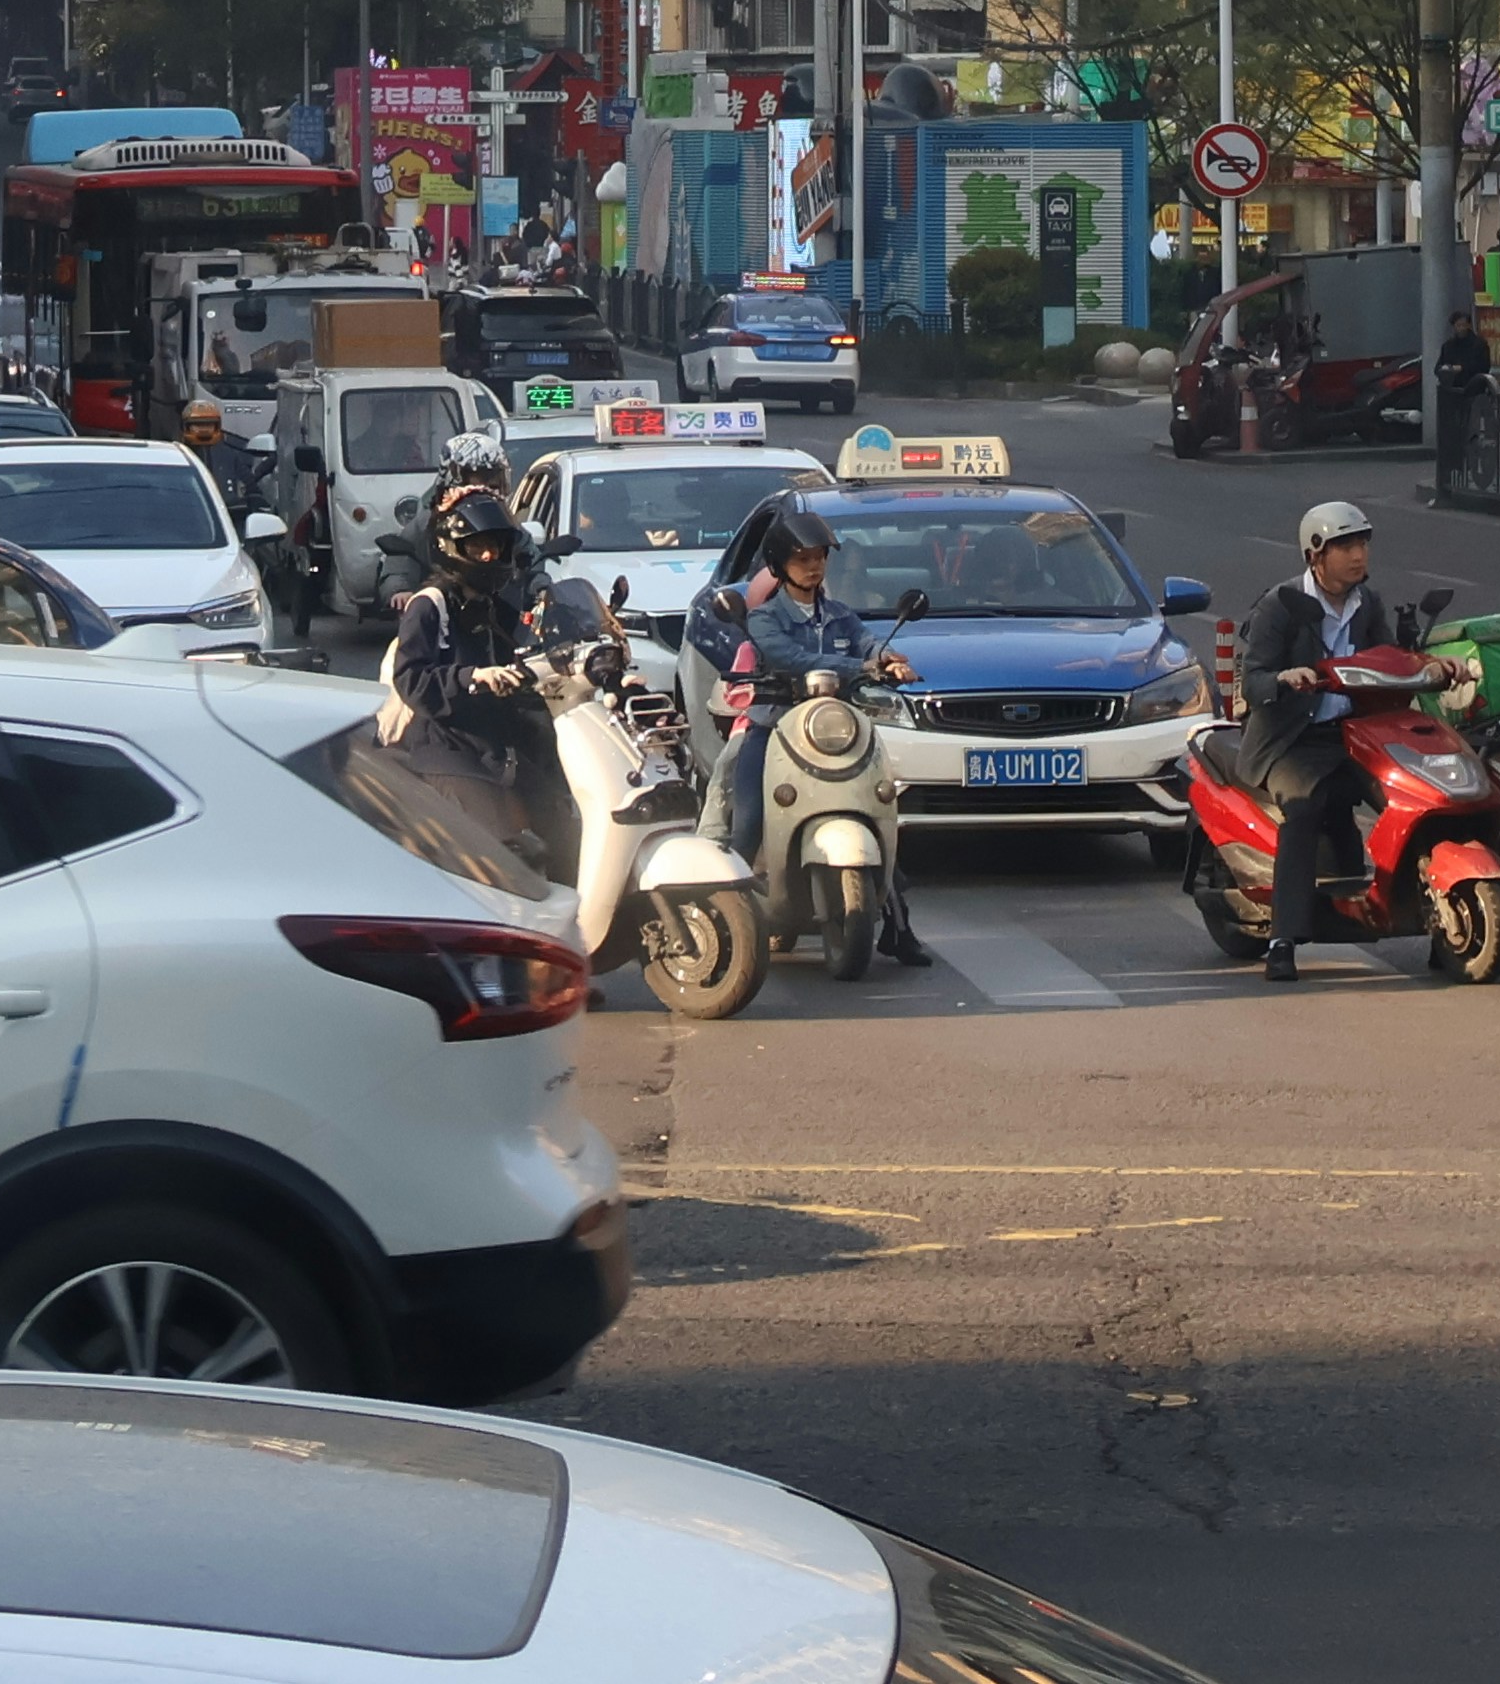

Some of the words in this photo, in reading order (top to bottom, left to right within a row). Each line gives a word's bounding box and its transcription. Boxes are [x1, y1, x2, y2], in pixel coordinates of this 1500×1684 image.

[371, 119, 463, 150] HEERS!
[1047, 221, 1072, 231] TAXI
[527, 386, 574, 410] 空车
[714, 411, 757, 428] 贵西
[954, 444, 993, 461] 黔运
[950, 462, 1000, 475] TAXI
[969, 753, 1081, 781] 贵A·UM102
